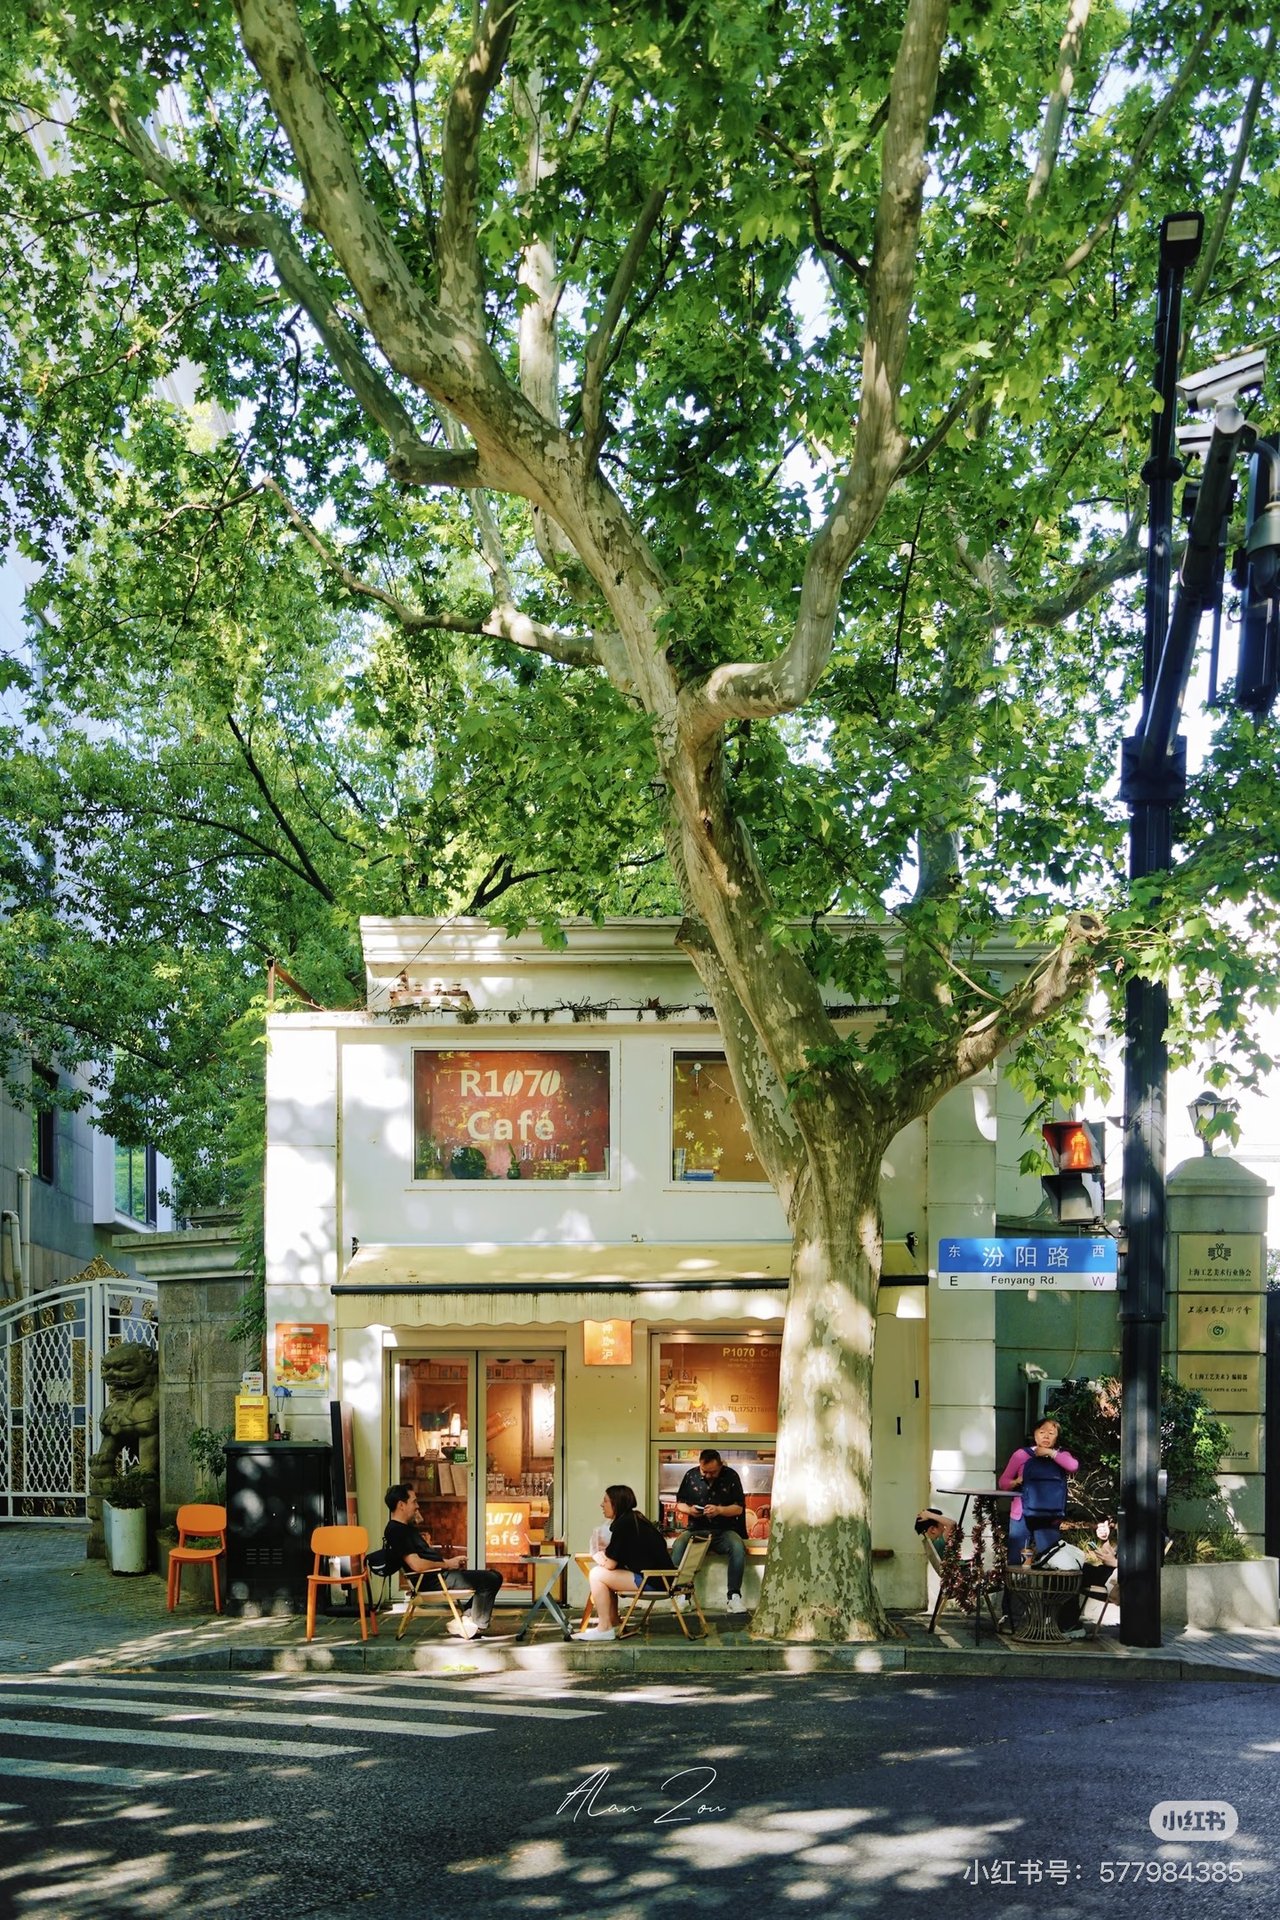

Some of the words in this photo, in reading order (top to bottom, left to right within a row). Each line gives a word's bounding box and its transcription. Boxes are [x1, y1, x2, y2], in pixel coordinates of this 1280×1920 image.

[460, 1069, 561, 1097] R1070
[467, 1109, 555, 1141] Café
[948, 1244, 961, 1258] 东
[982, 1246, 1070, 1268] 汾阳路
[1092, 1244, 1106, 1258] 西
[950, 1276, 958, 1286] E
[991, 1275, 1035, 1287] Fenyang
[1040, 1275, 1058, 1285] Rd.
[1092, 1276, 1105, 1286] W
[486, 1530, 520, 1545] afé
